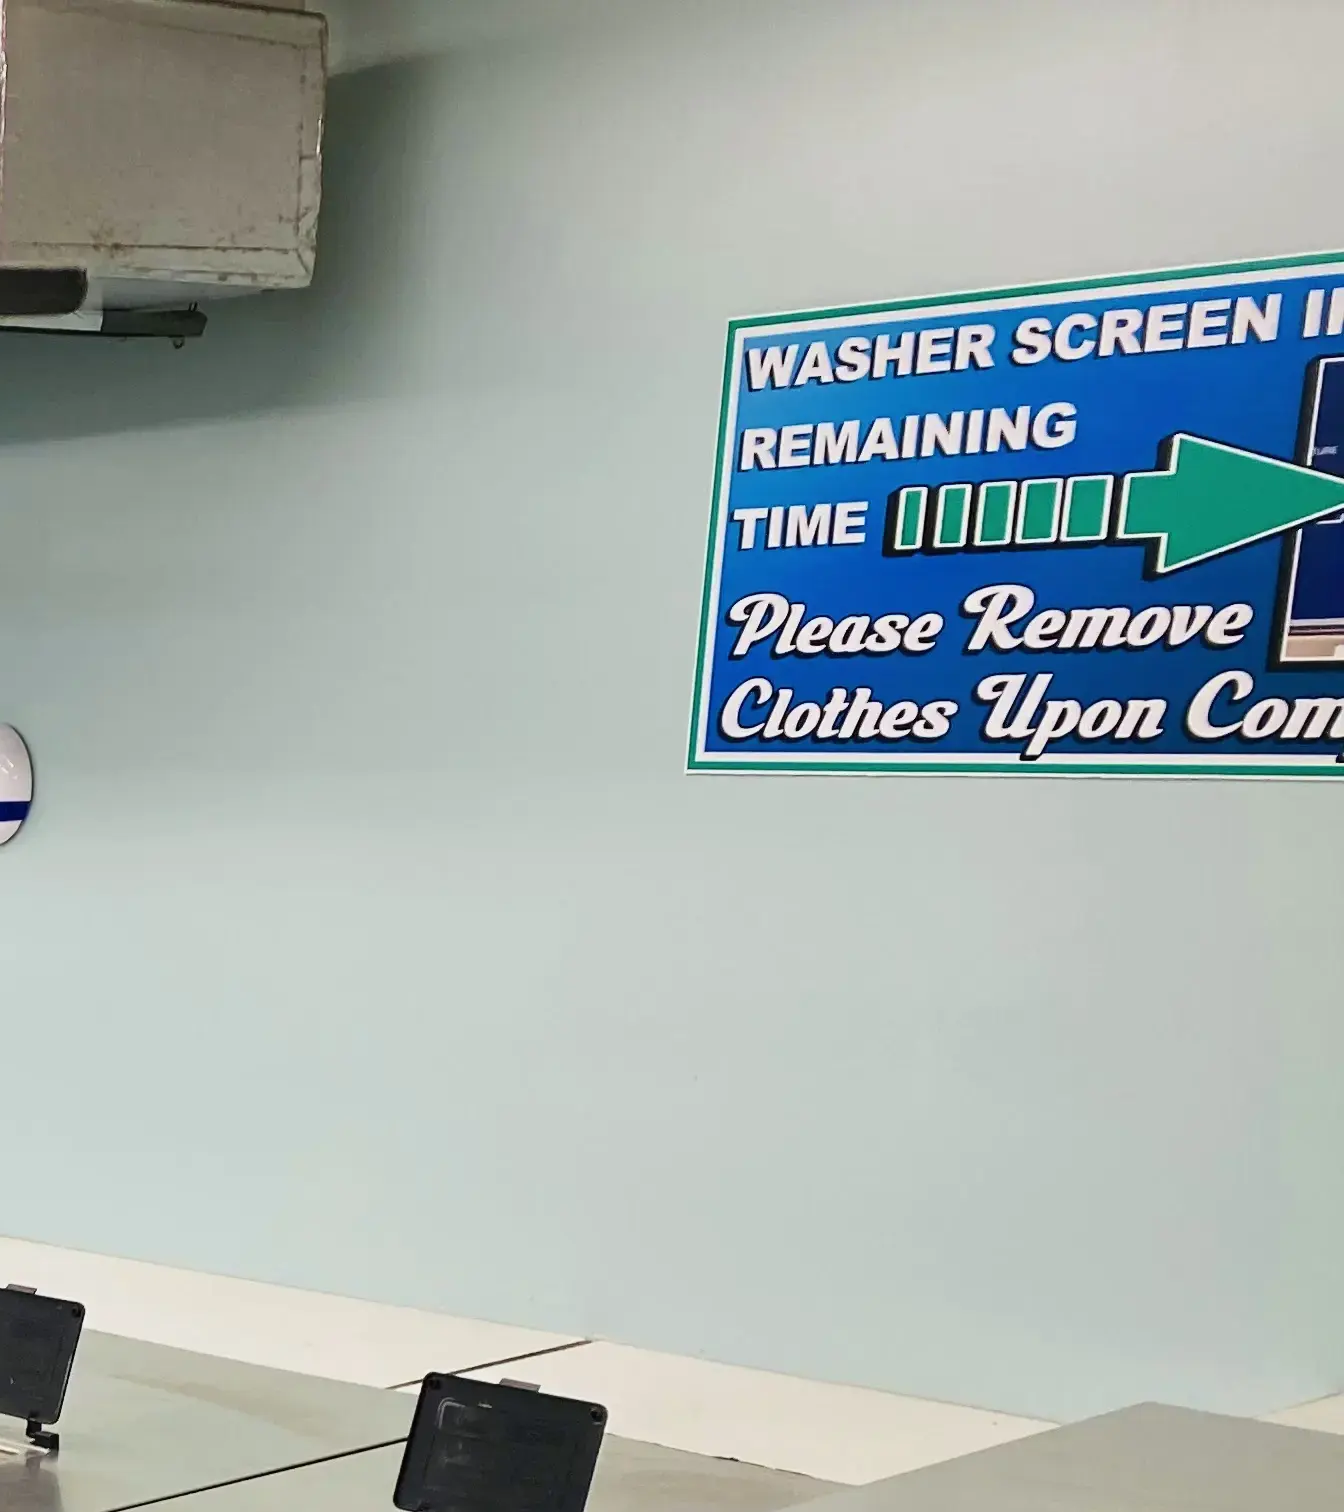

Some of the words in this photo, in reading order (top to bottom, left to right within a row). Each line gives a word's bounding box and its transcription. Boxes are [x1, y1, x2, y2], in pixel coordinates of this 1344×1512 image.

[748, 324, 997, 390] WASHER
[1012, 293, 1283, 364] SCREEN
[739, 401, 1077, 471] REMAINING
[733, 501, 869, 550] TIME
[728, 592, 944, 656] Please
[963, 584, 1254, 652] Remove
[720, 676, 959, 741] Clothes
[976, 672, 1167, 758] Upon
[1185, 669, 1344, 762] Com
